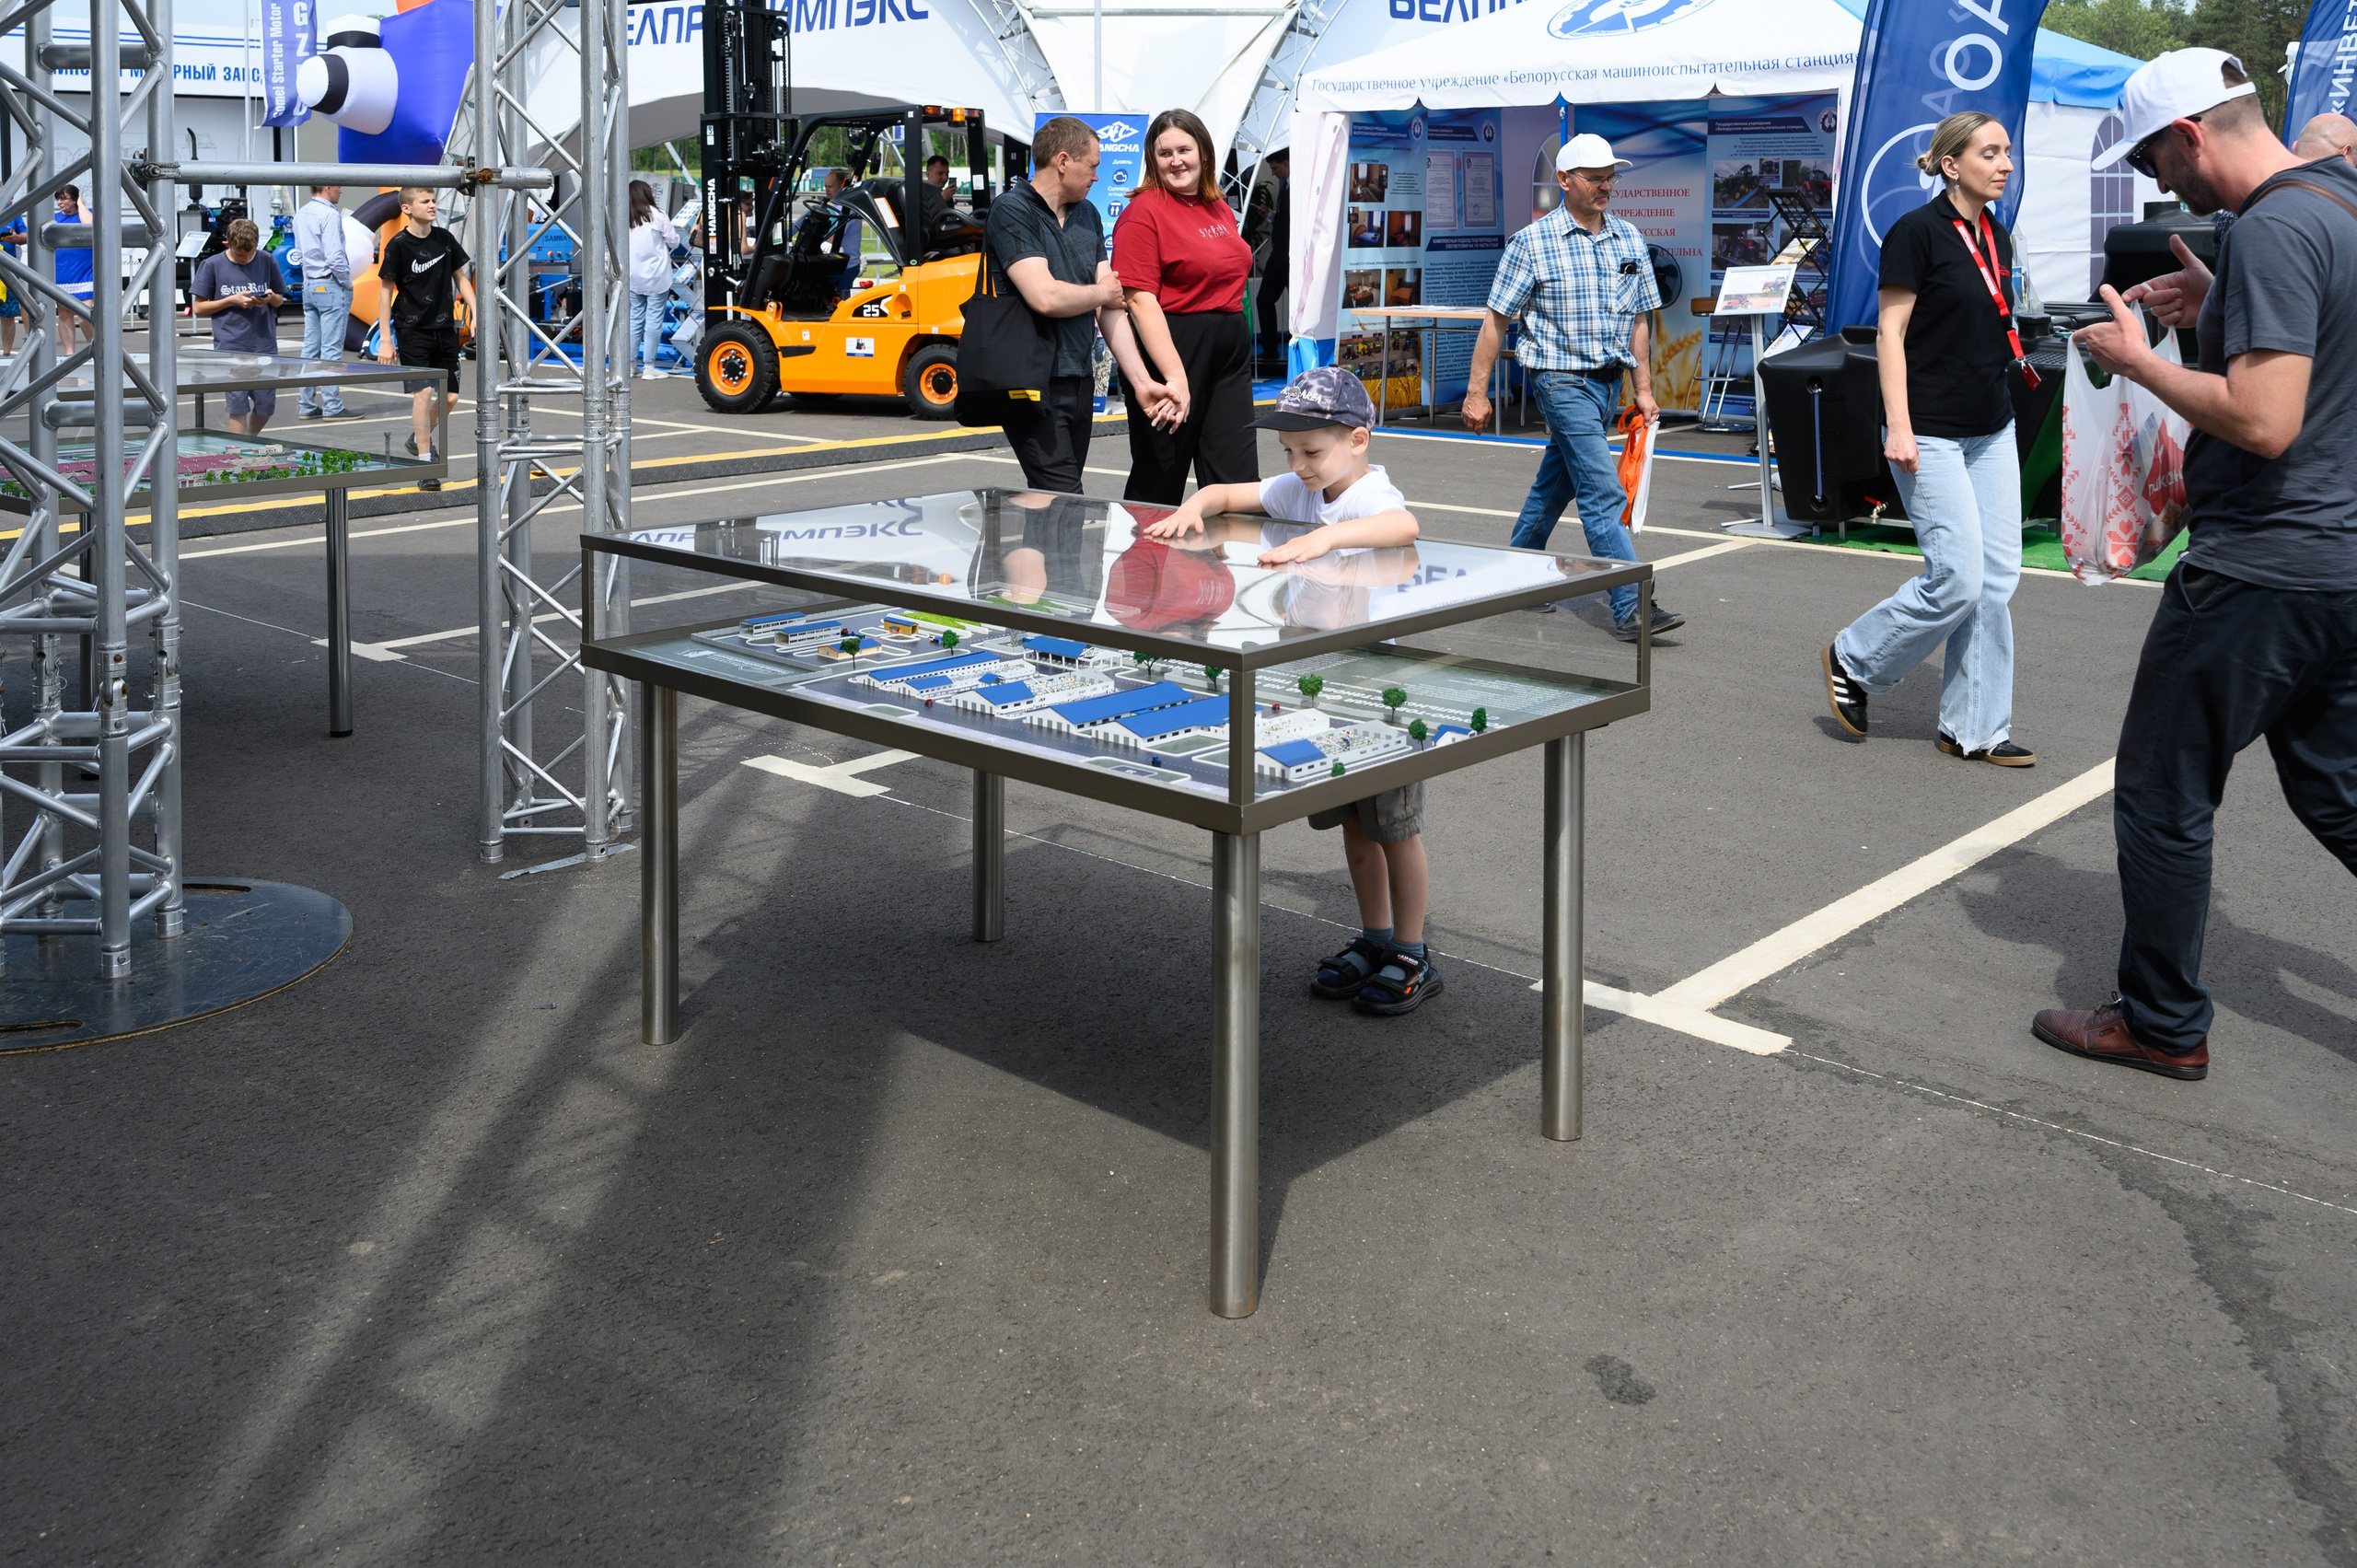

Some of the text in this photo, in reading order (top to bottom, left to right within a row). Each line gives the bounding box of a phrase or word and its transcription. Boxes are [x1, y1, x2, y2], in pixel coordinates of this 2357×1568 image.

[270, 3, 283, 38] Motor
[272, 41, 284, 84] Starter
[1312, 79, 1416, 93] Государственное
[1420, 76, 1499, 92] учреждение
[1503, 69, 1597, 85] «Белорусская
[1601, 58, 1780, 80] машиноиспытательная
[1099, 144, 1140, 153] ANGCHA
[1610, 188, 1689, 198] СУДАРСТВЕННОЕ
[707, 178, 717, 237] HANGCHA
[1611, 208, 1676, 218] УЧРЕЖДЕНИЕ
[1639, 227, 1676, 237] УССКАЯ
[1657, 248, 1703, 257] АТЕЛЬНА
[863, 304, 880, 318] 25
